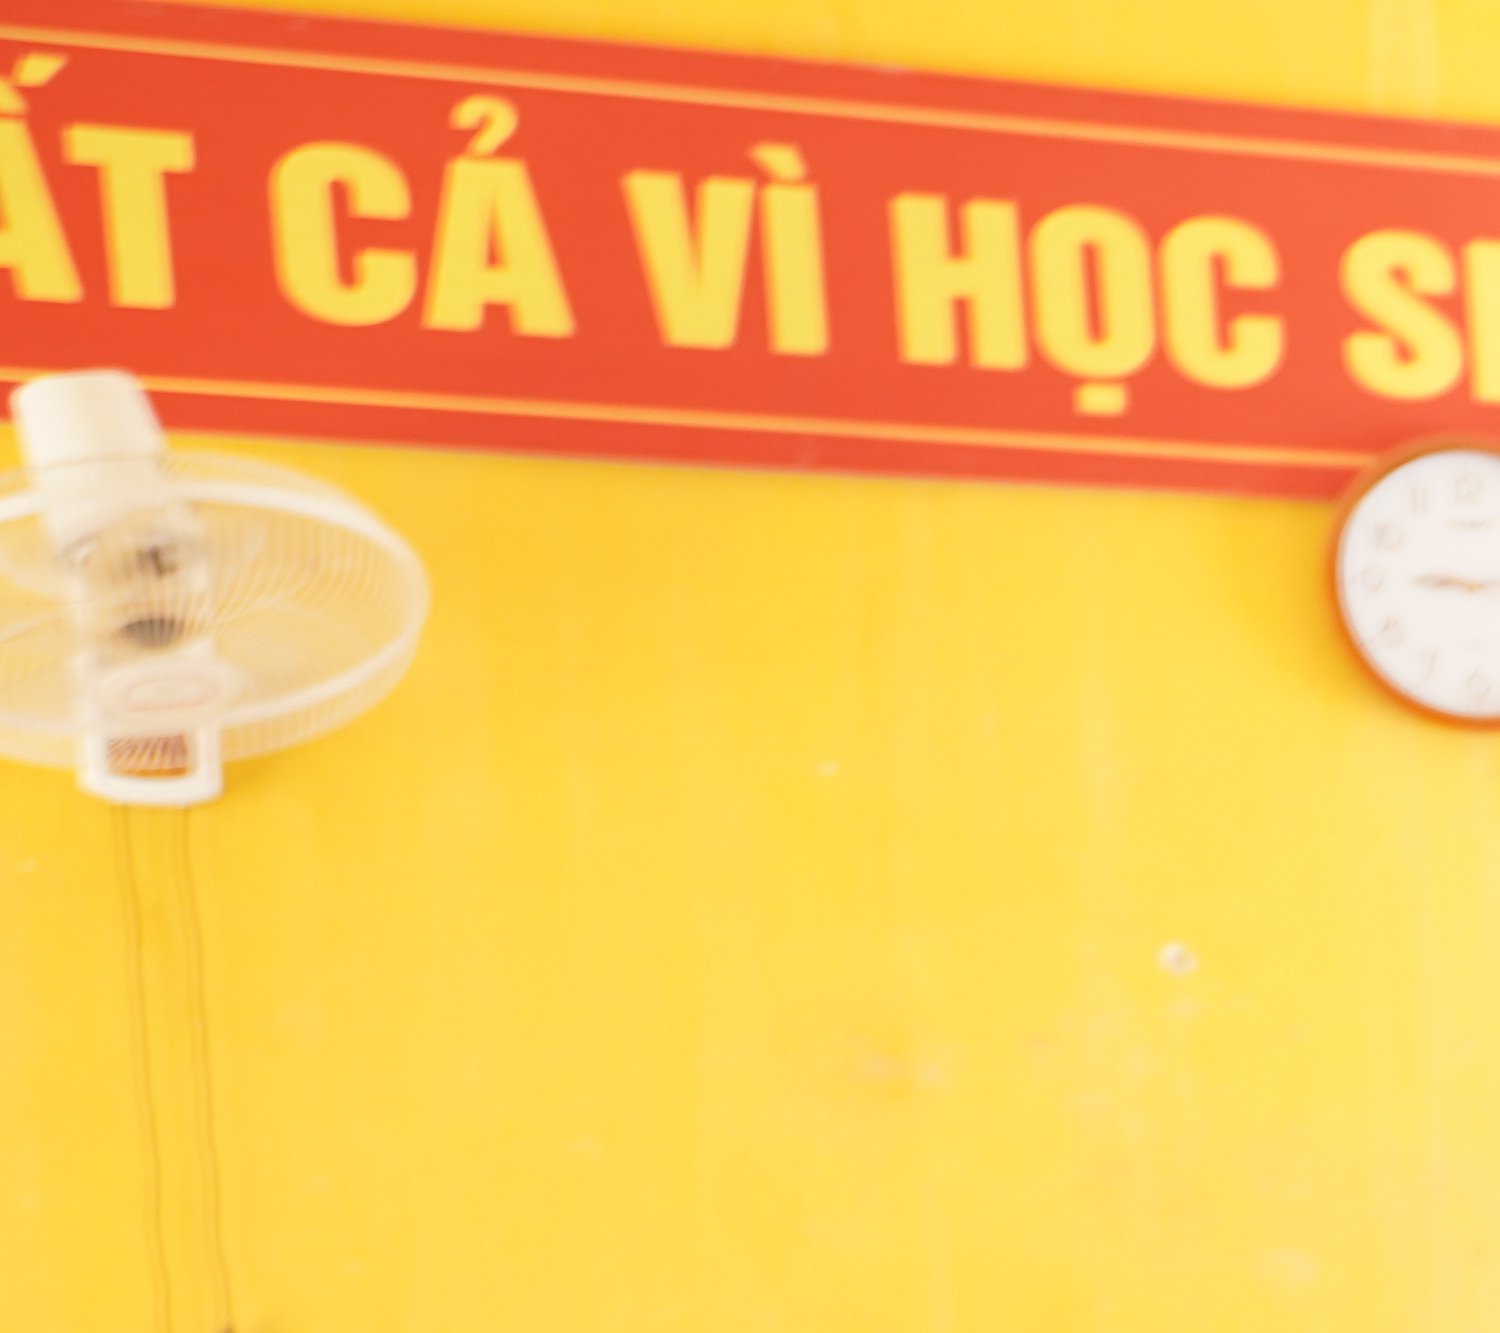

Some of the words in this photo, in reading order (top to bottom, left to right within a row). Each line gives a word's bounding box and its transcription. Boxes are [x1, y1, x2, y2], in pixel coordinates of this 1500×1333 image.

[268, 96, 574, 338] CẢ
[622, 144, 829, 356] VÌ
[890, 193, 1284, 416] HỌC
[1408, 485, 1430, 516] 11
[1454, 469, 1485, 505] 12
